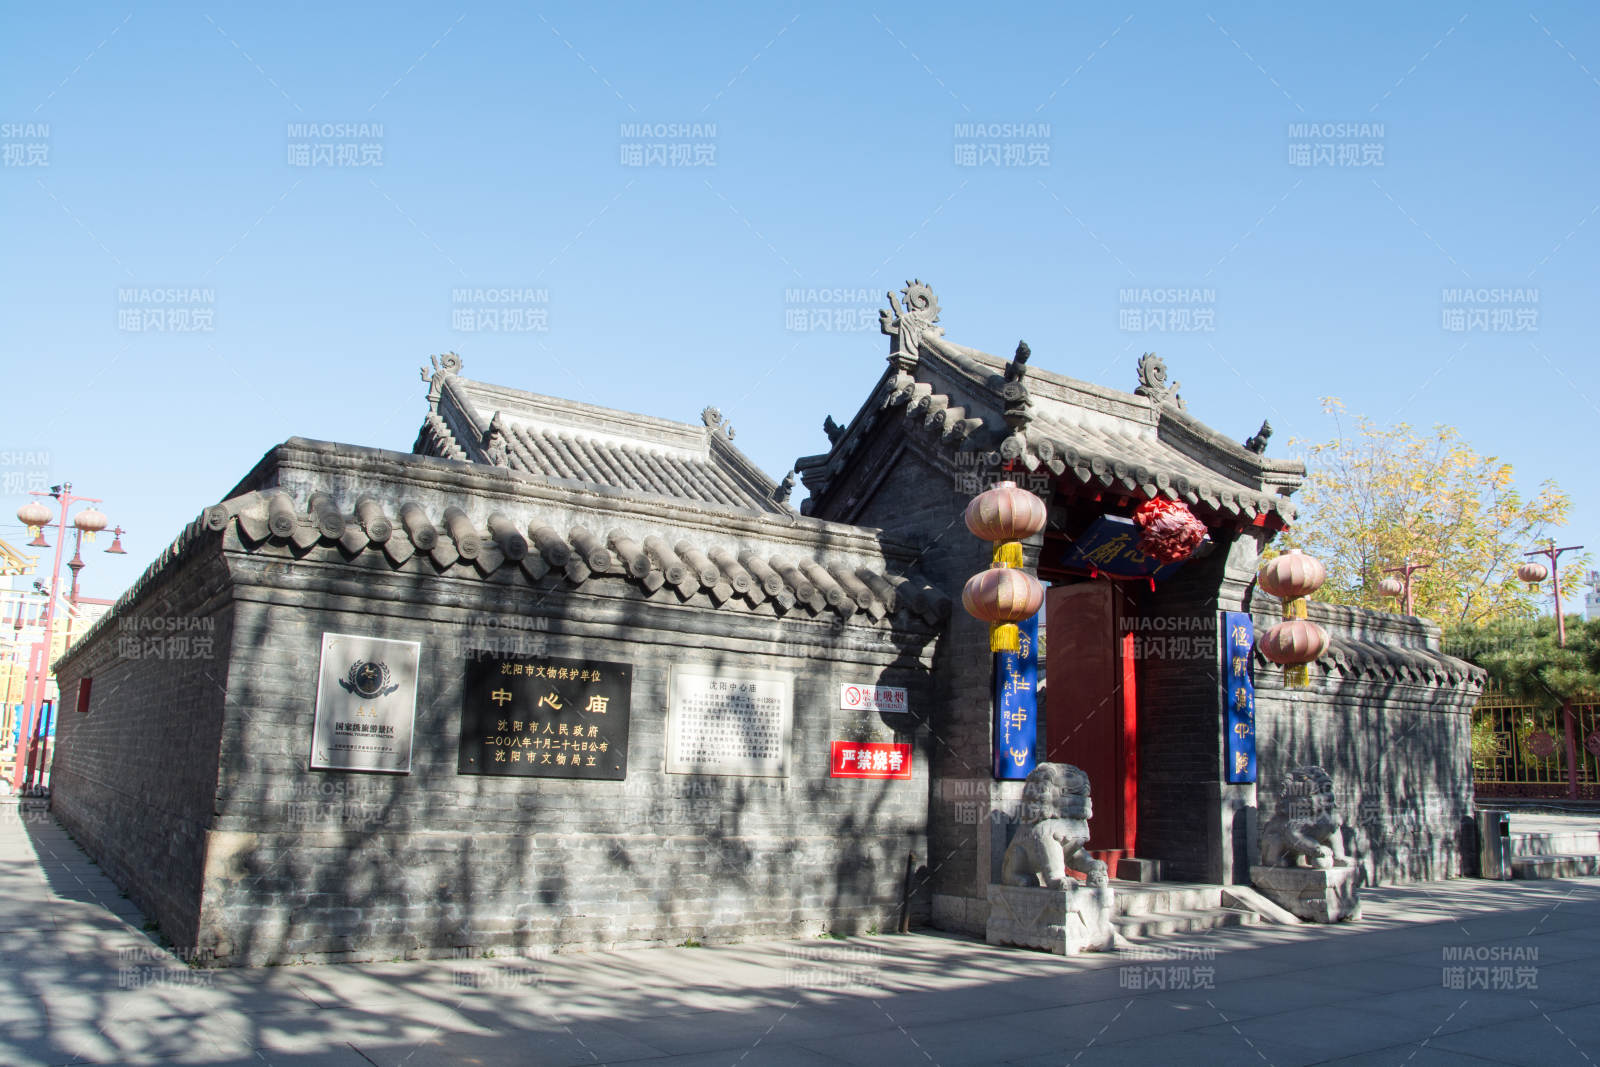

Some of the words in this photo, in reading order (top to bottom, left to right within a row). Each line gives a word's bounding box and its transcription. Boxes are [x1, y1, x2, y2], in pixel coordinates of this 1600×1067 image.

[500, 662, 602, 682] 沈阳市文物保护单位
[709, 681, 757, 693] 沈阳中心庙
[862, 688, 905, 703] 禁止吸烟
[491, 688, 610, 713] 中心庙
[335, 722, 395, 734] 国家级旅游景区
[497, 719, 599, 737] 沈阳市人民政府
[495, 750, 597, 766] 沈阳市文物局立
[841, 749, 904, 771] 严禁烧香
